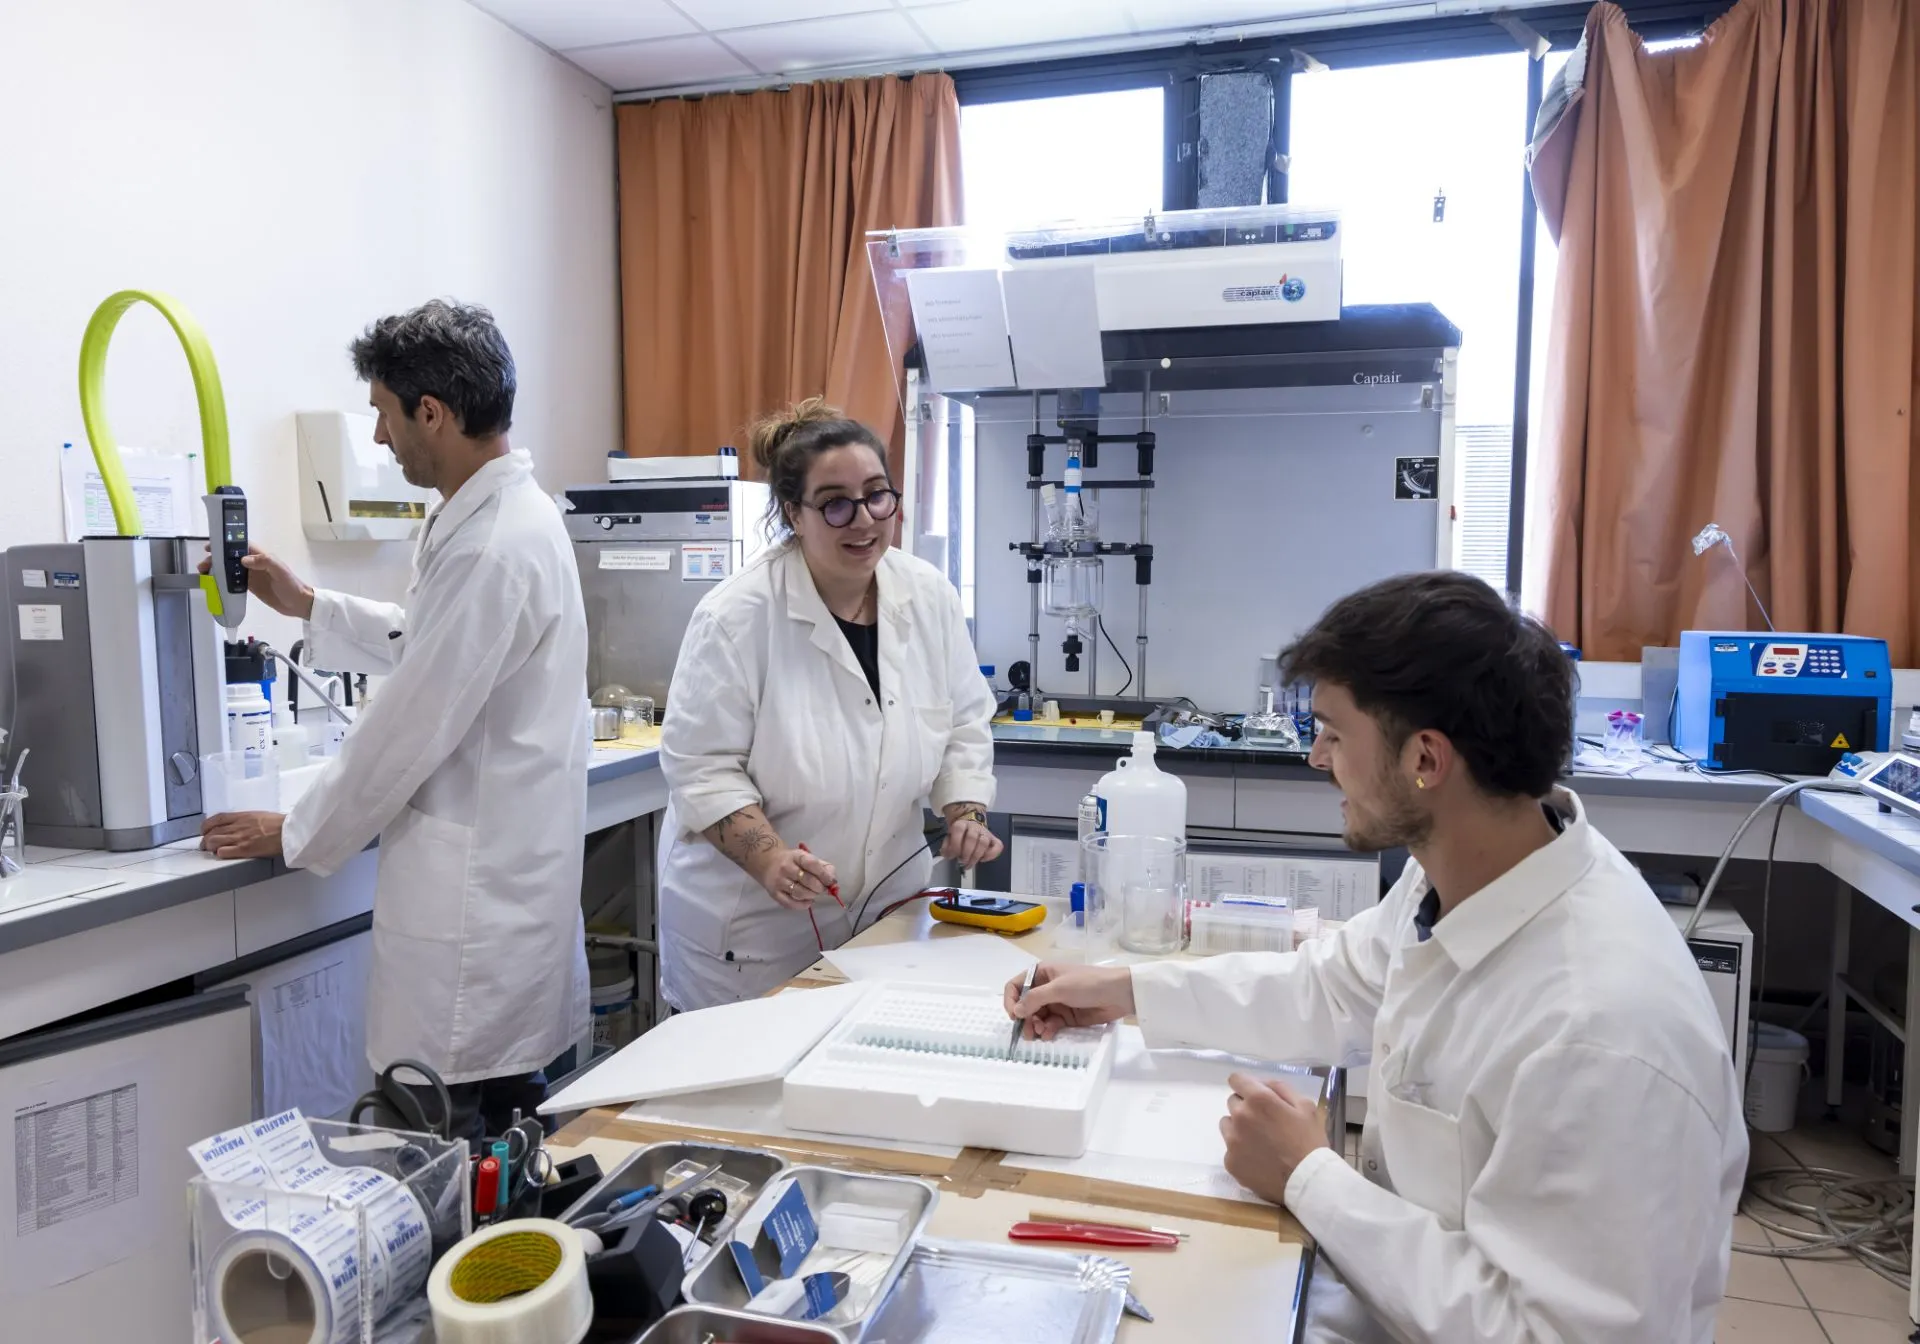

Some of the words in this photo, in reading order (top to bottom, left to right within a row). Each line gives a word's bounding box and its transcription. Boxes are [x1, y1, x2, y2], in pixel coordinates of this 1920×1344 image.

[1353, 370, 1402, 387] Captair
[253, 1111, 296, 1137] PARAFILM
[202, 1136, 245, 1162] PARAFILM
[288, 1165, 330, 1190] PARAFILM
[386, 1221, 425, 1254] PARAFILM
